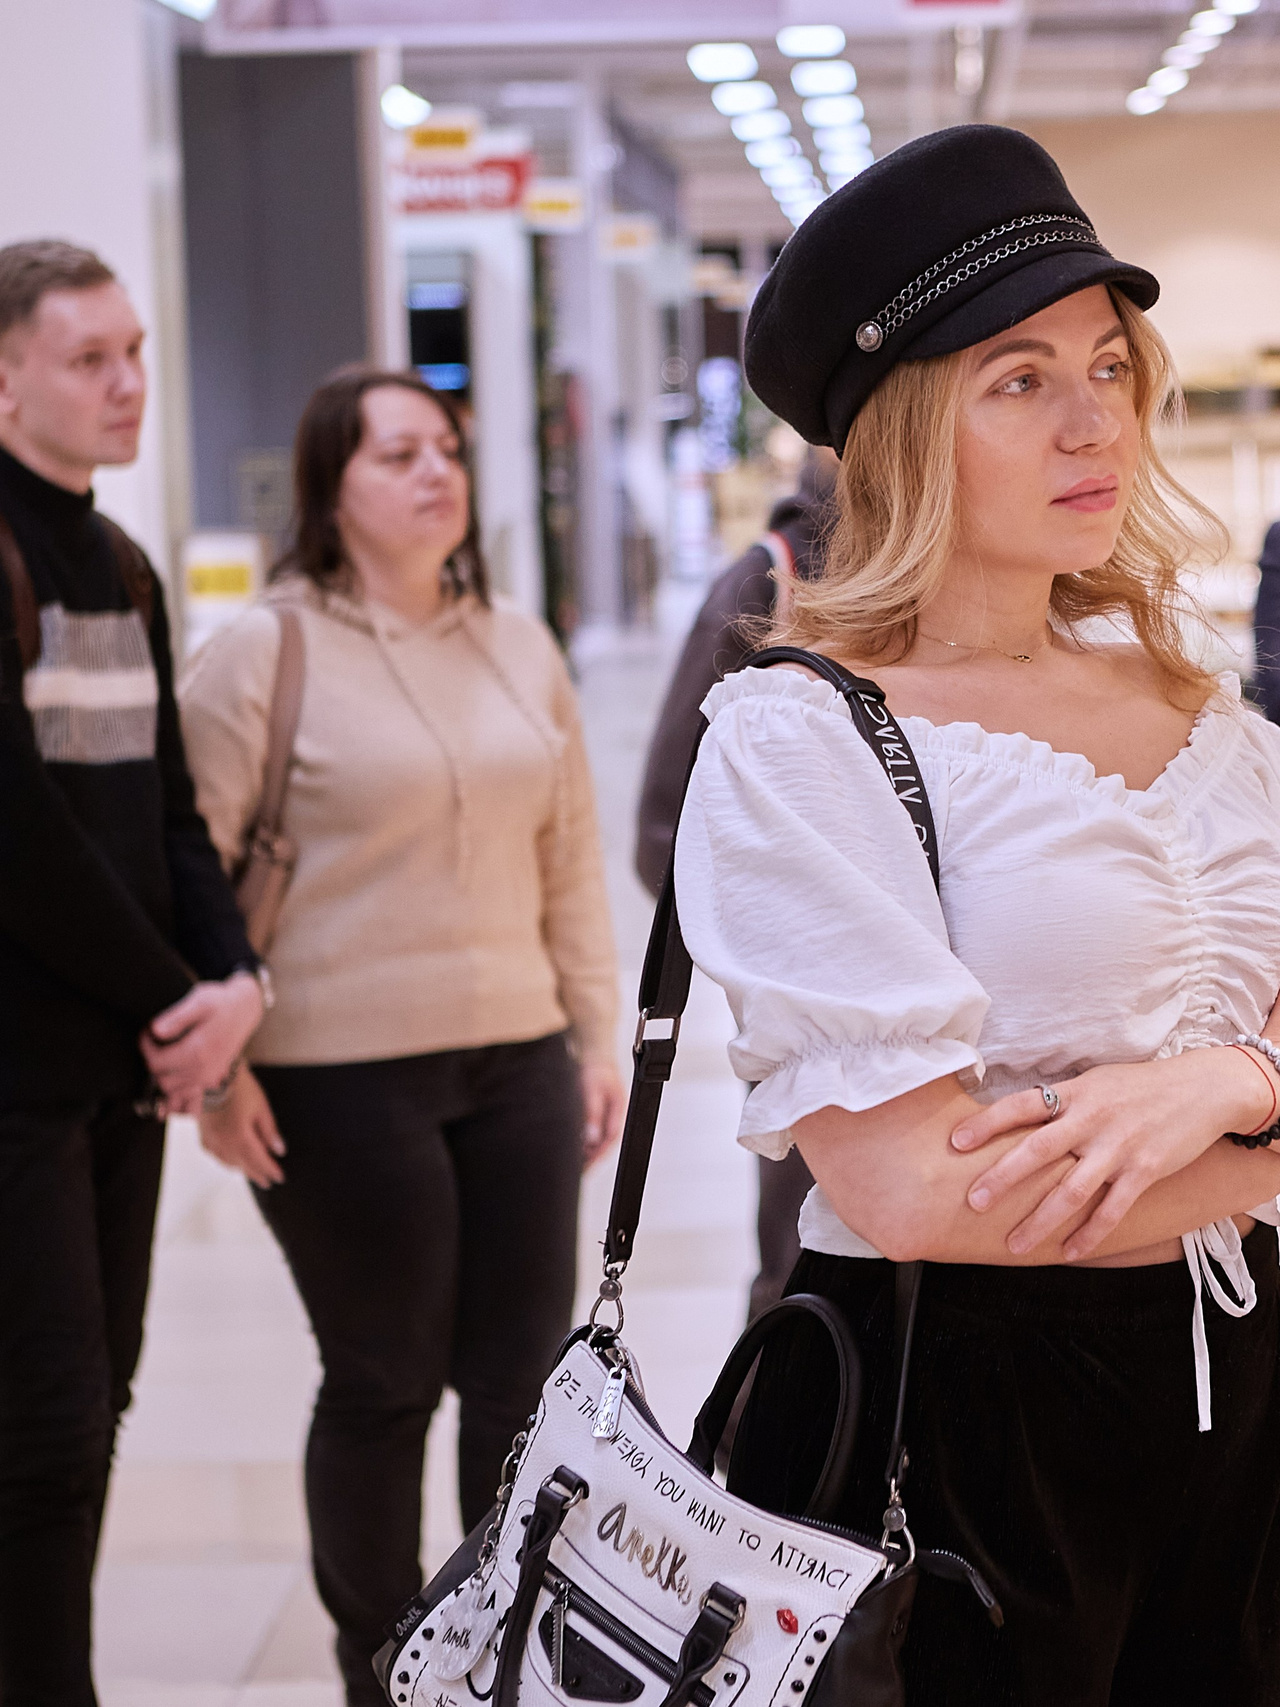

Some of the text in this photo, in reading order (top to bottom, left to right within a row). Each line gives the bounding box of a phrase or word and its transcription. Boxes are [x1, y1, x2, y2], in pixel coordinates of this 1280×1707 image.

[554, 1369, 853, 1591] BE TH NERGY YOU WANT TO ATTRACT
